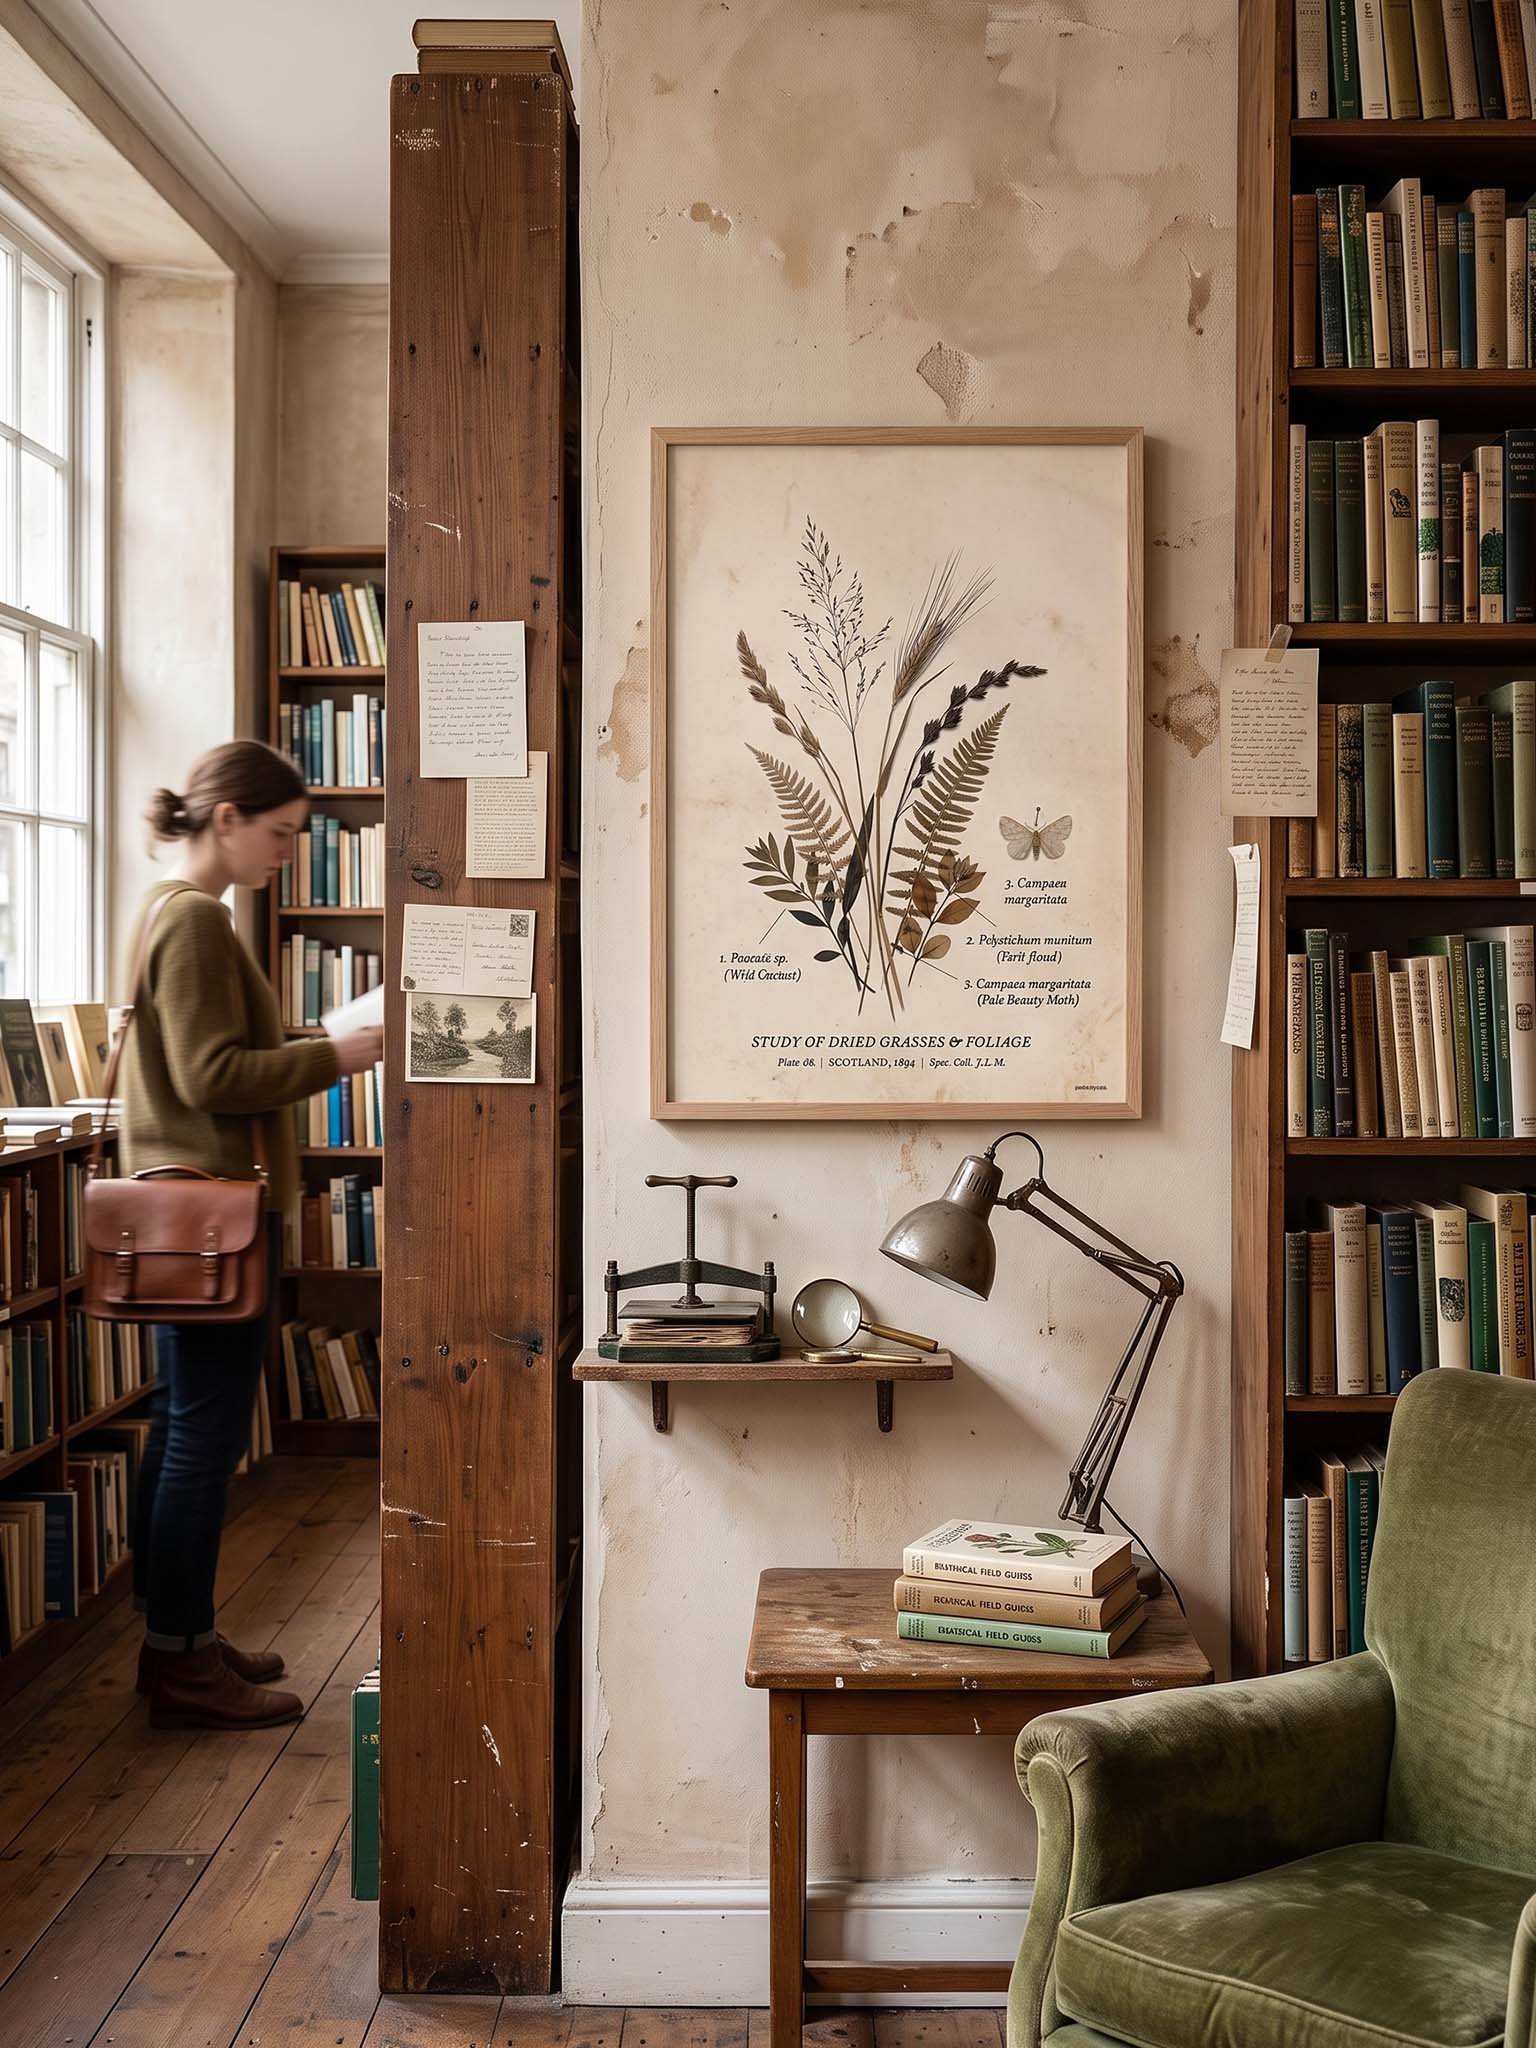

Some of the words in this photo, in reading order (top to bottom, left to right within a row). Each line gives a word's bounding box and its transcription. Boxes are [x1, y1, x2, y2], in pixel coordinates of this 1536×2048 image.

[1004, 879, 1014, 890] 3.
[1004, 894, 1068, 908] margaritata
[966, 936, 975, 945] 2.
[1043, 935, 1093, 945] munitum
[719, 955, 727, 963] 1.
[773, 955, 788, 967] sp.
[976, 978, 1026, 991] Campaea
[1028, 978, 1092, 992] margaritata
[977, 994, 1005, 1008] (Pale
[1006, 994, 1045, 1008] Beauty
[1045, 994, 1080, 1008] Moth)
[751, 1035, 802, 1048] STUDY
[804, 1035, 826, 1048] OF
[828, 1035, 876, 1048] DRIED
[879, 1035, 946, 1048] GRASSES
[948, 1036, 963, 1048] &
[965, 1035, 1032, 1048] FOLIAGE
[777, 1057, 800, 1067] Plate
[828, 1057, 892, 1069] SCOTLAND,
[893, 1057, 915, 1069] 1894
[929, 1057, 951, 1069] Spec.
[953, 1057, 973, 1067] Coll.
[980, 1567, 1002, 1578] FIELD
[979, 1600, 1002, 1610] FIELD
[985, 1630, 1009, 1641] FIELD
